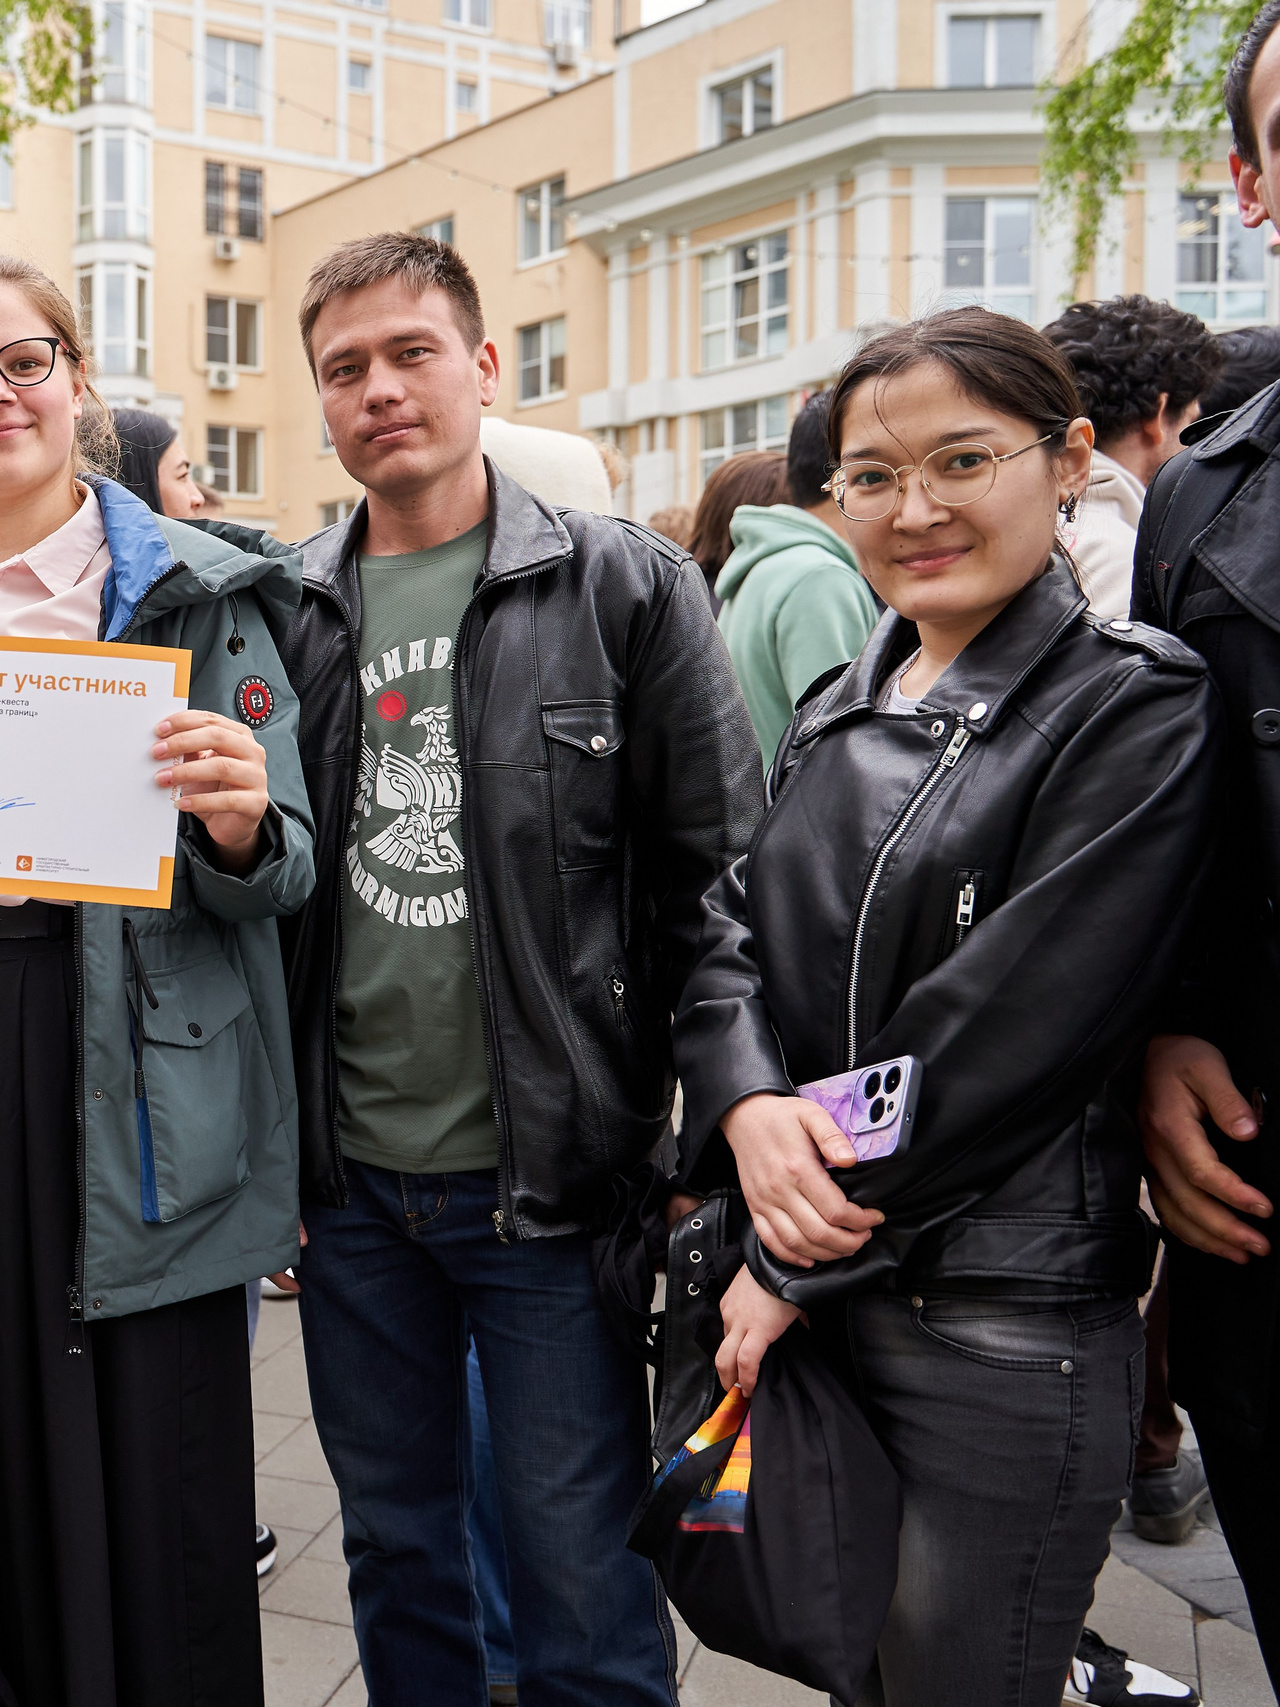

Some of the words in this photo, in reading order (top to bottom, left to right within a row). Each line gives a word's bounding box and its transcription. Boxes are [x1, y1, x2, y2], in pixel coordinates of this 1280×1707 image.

[360, 636, 455, 696] KHAB
[14, 673, 147, 697] участника
[5, 708, 38, 717] границ»
[425, 764, 461, 773] RUSSI
